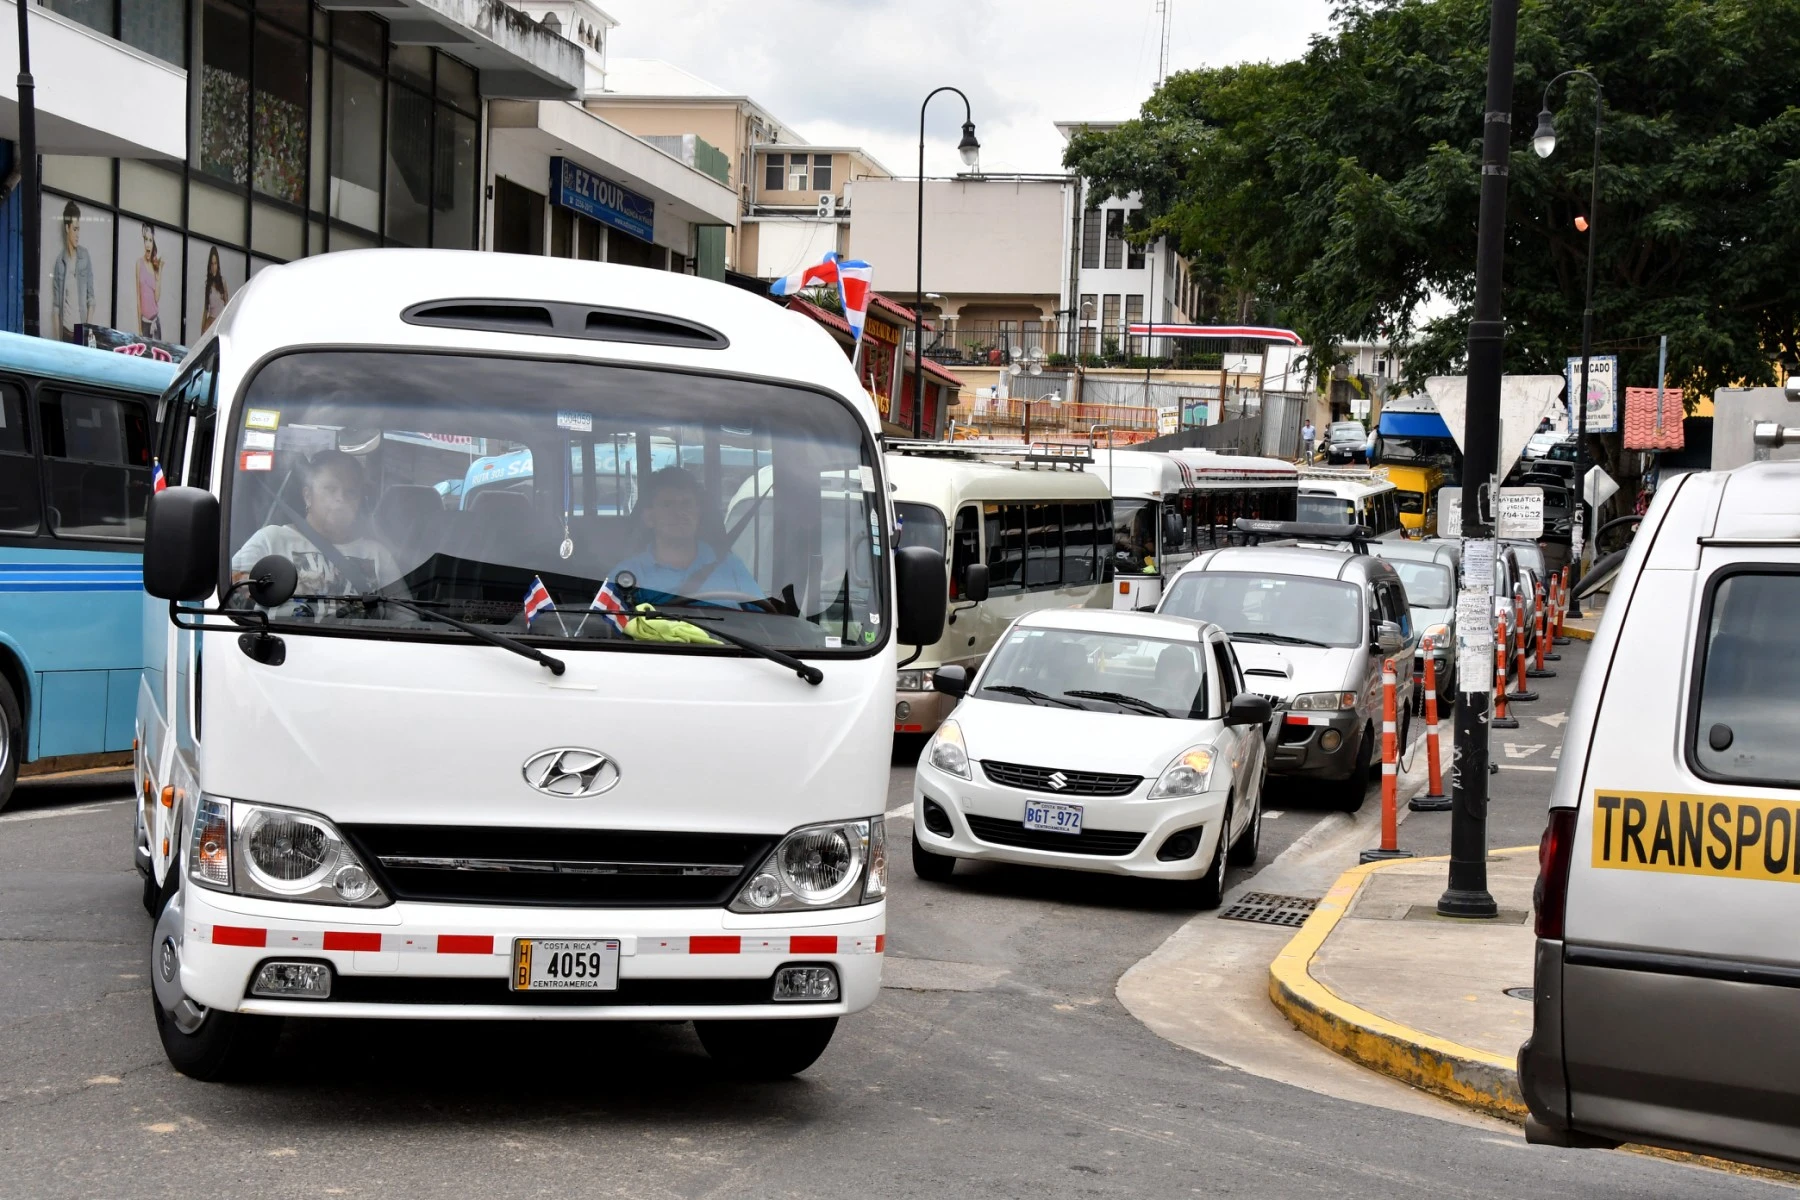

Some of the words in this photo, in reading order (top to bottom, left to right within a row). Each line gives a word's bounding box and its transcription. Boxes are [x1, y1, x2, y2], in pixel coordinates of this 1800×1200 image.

[575, 169, 590, 197] EZ
[591, 177, 624, 212] TOUR
[1573, 362, 1610, 374] MCADO
[1027, 807, 1080, 828] BGT-972
[544, 942, 570, 950] COSTA
[573, 942, 591, 950] RICA
[547, 952, 601, 978] 4059
[532, 980, 598, 988] CENTROAMERICA
